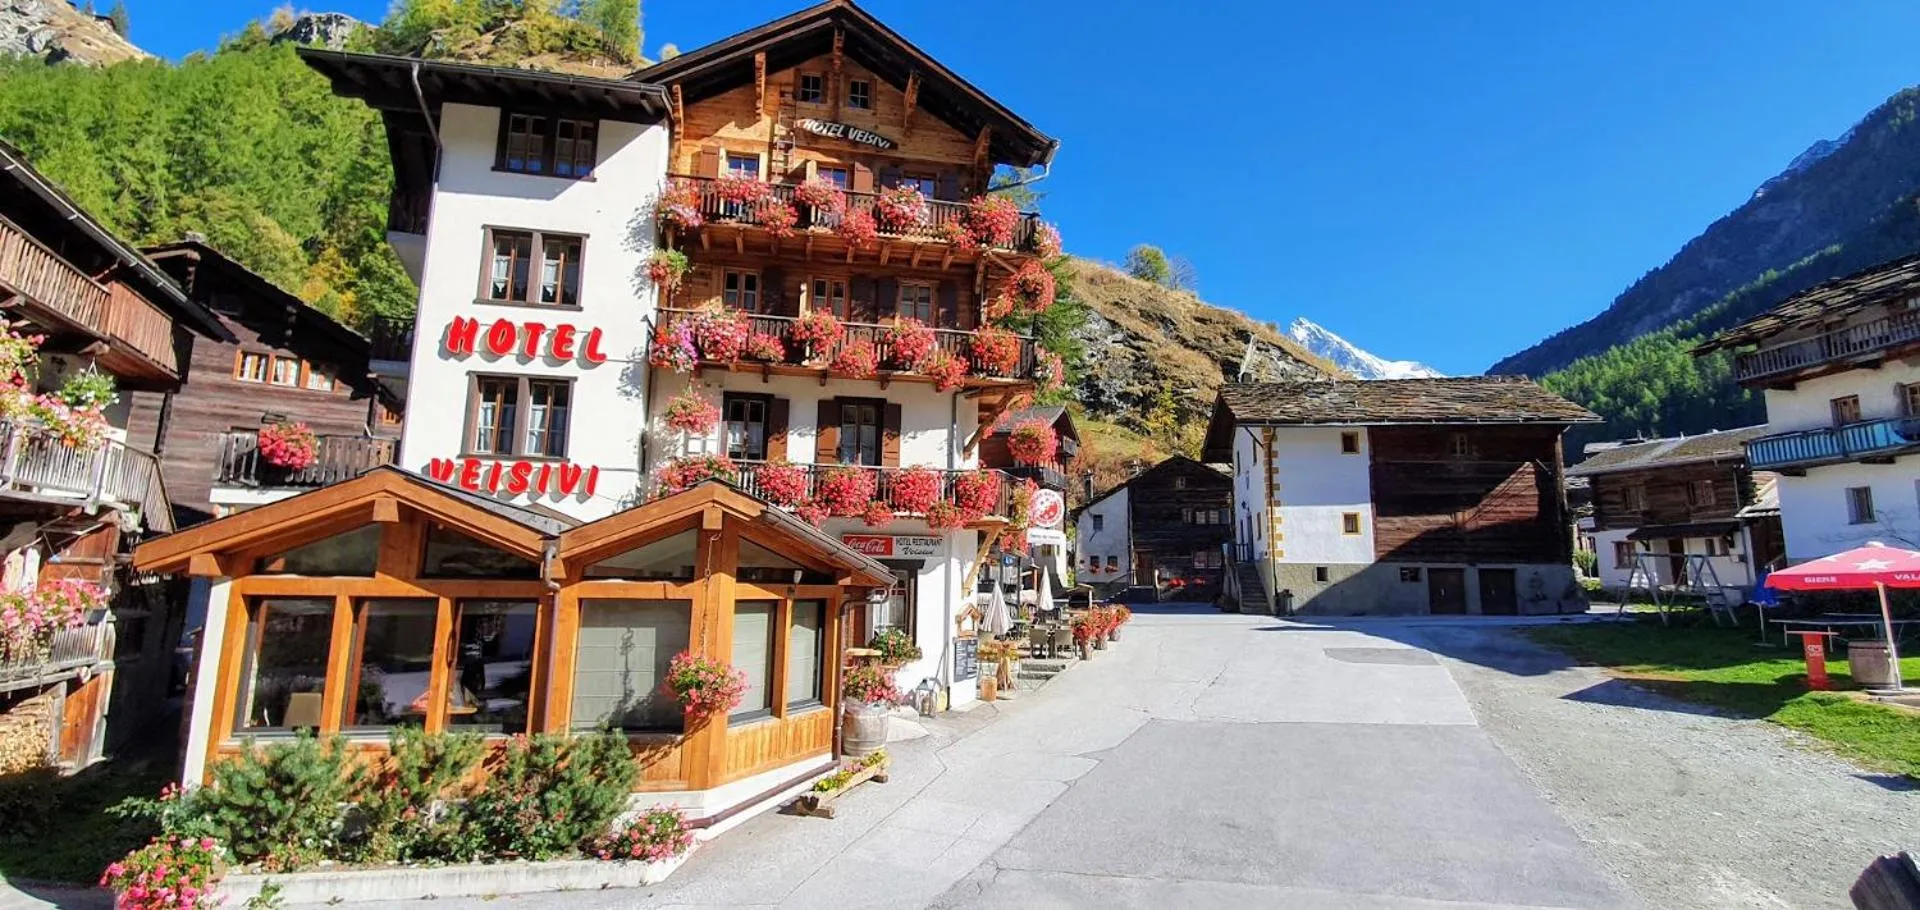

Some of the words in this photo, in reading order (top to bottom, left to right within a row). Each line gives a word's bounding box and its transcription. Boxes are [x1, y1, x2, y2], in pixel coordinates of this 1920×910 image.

[803, 119, 844, 138] HOTEL
[848, 127, 891, 149] VEISIVI
[446, 315, 607, 362] HOTEL
[430, 457, 599, 496] VEISIVI
[896, 537, 911, 546] HOTEL
[912, 537, 943, 546] RESTAURANT
[1894, 573, 1920, 581] VAL
